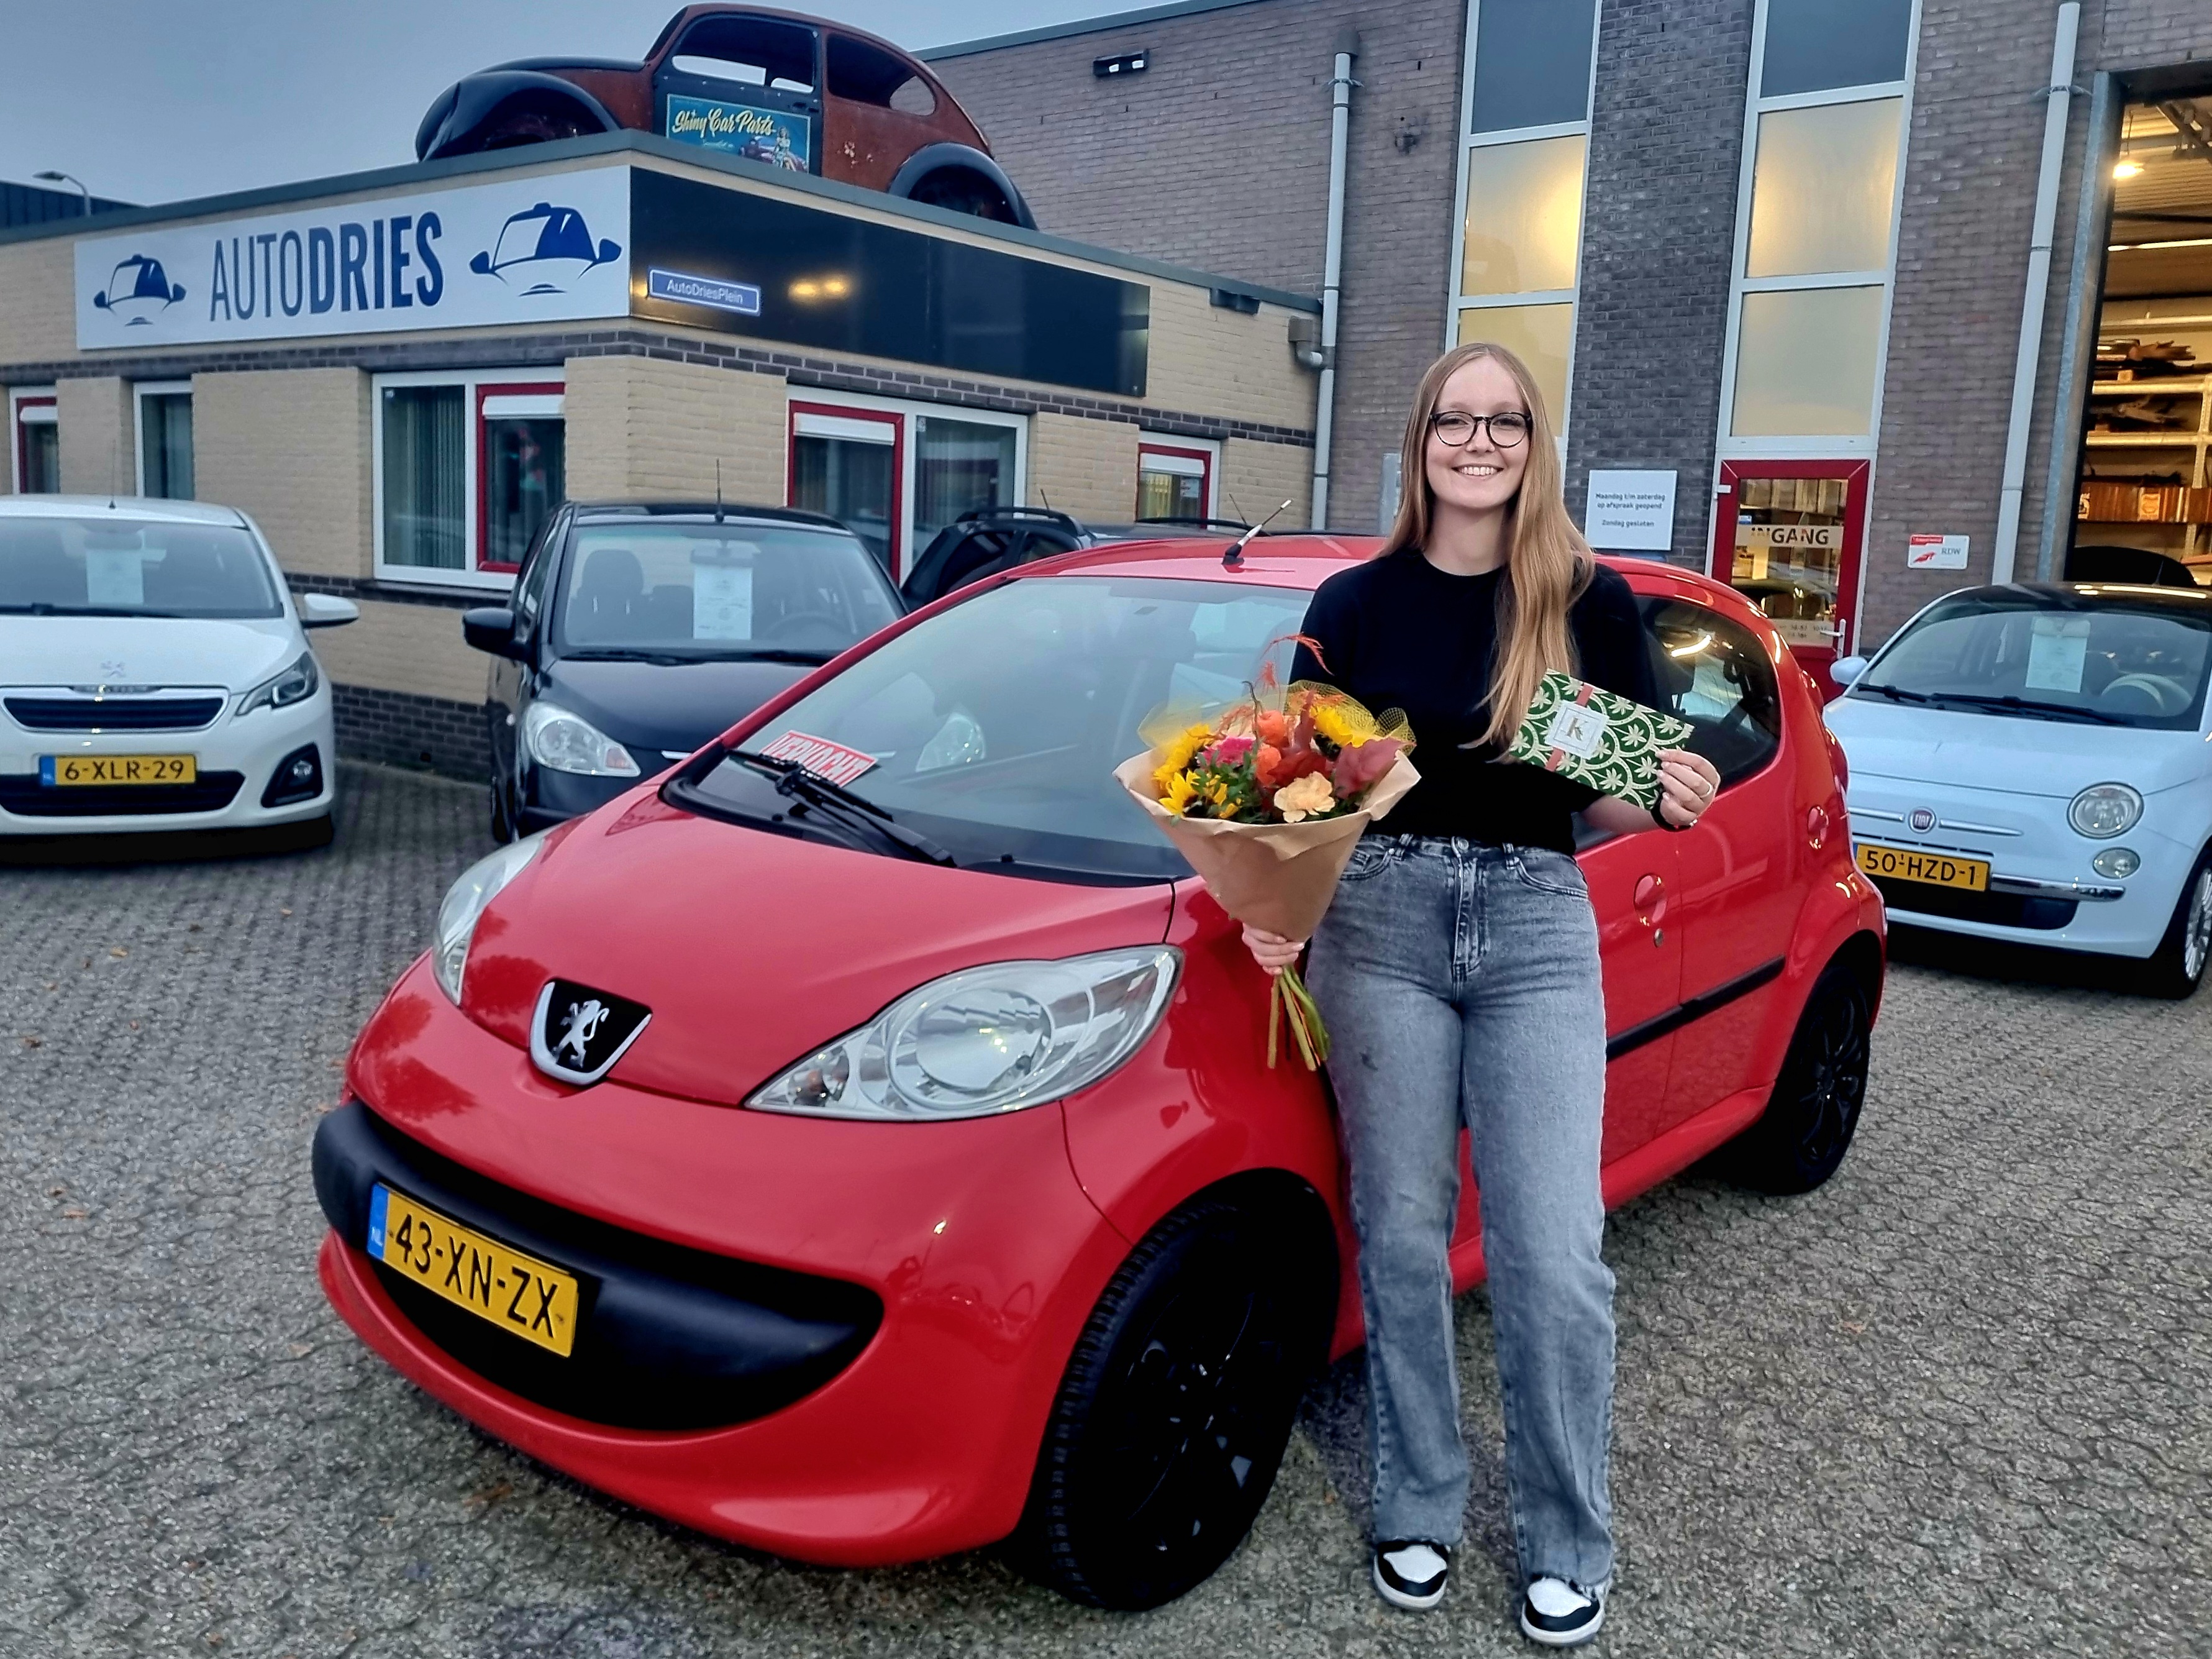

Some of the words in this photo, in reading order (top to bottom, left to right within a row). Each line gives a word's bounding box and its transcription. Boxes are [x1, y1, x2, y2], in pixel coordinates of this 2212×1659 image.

[671, 109, 708, 139] Shiny
[708, 107, 735, 138] Car
[735, 109, 776, 136] Parts
[210, 211, 444, 322] AUTODRIES
[667, 279, 744, 304] AutoDriesPlein
[1602, 519, 1624, 528] Zondag
[65, 760, 184, 780] 6-XLR-29
[1914, 814, 1931, 826] FIAT
[396, 1213, 558, 1338] 43-XN-ZX
